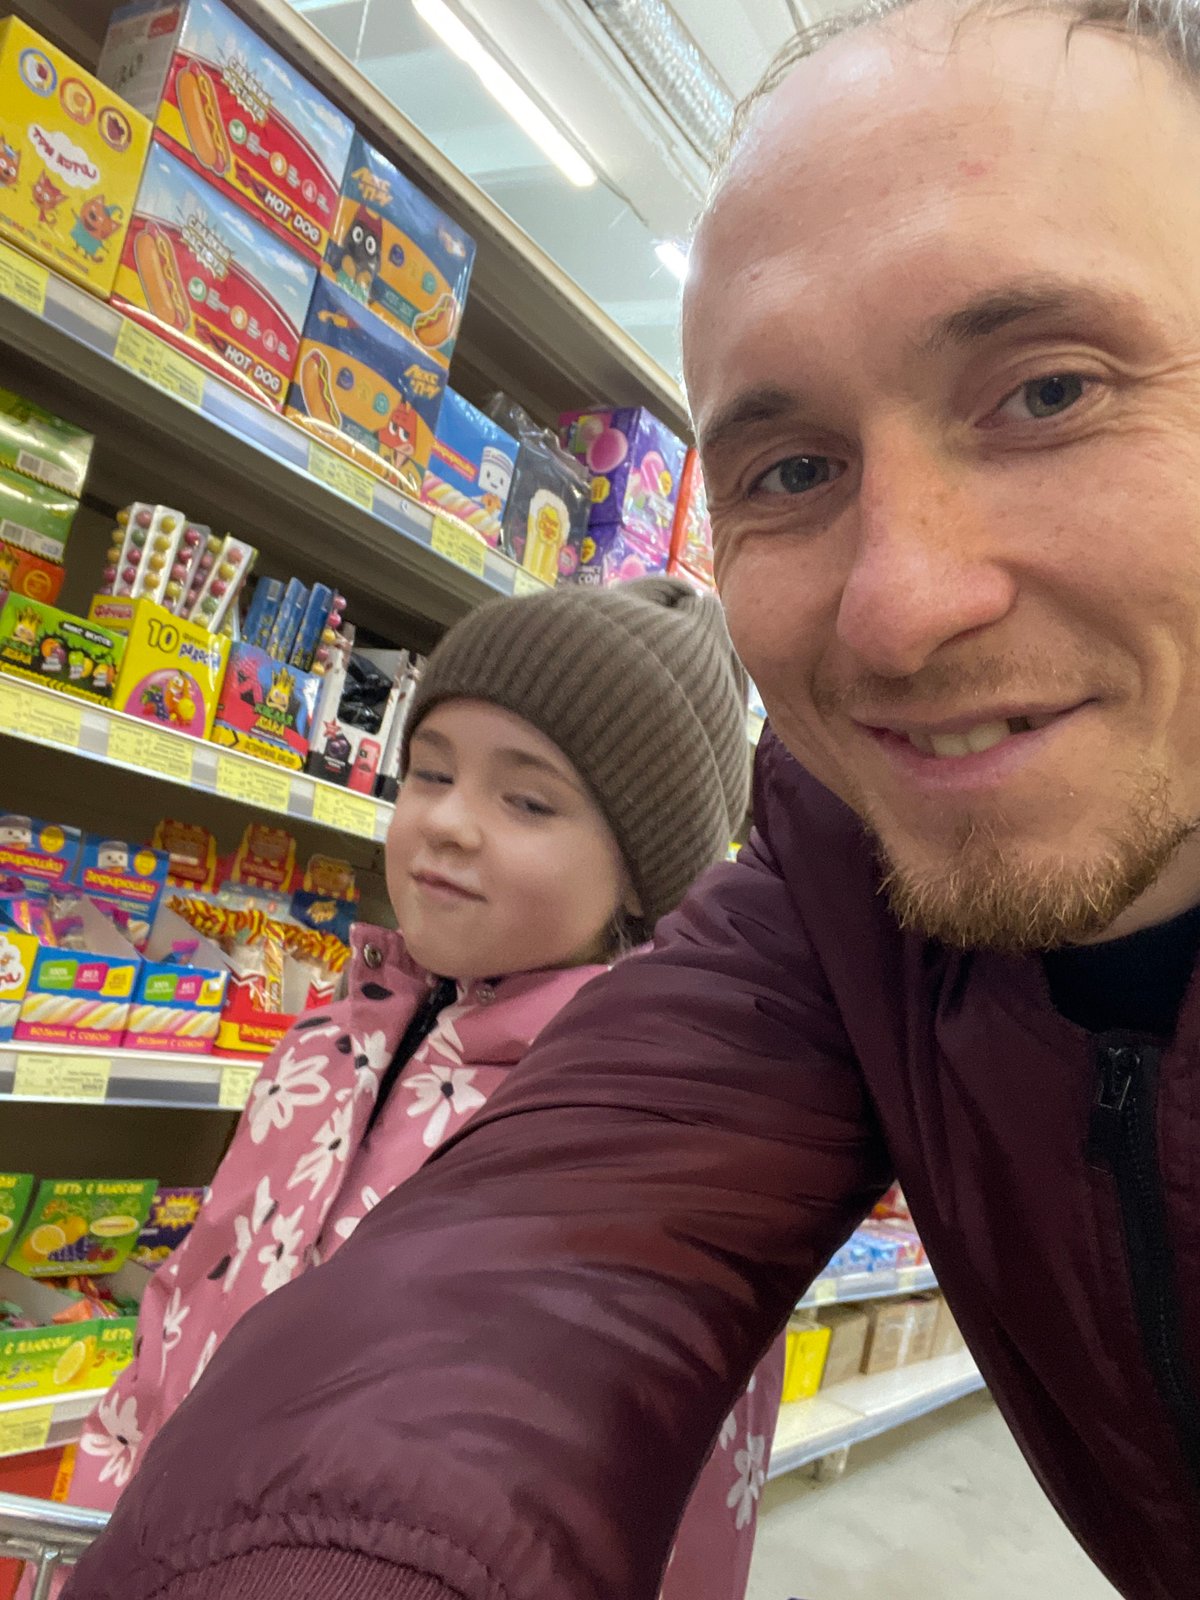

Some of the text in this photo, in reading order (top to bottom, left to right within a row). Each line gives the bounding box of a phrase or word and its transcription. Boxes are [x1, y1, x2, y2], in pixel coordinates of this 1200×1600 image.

[264, 190, 292, 219] HOT
[293, 214, 321, 243] DOG
[224, 344, 252, 370] HOT
[254, 366, 280, 391] DOG
[148, 618, 179, 653] 10
